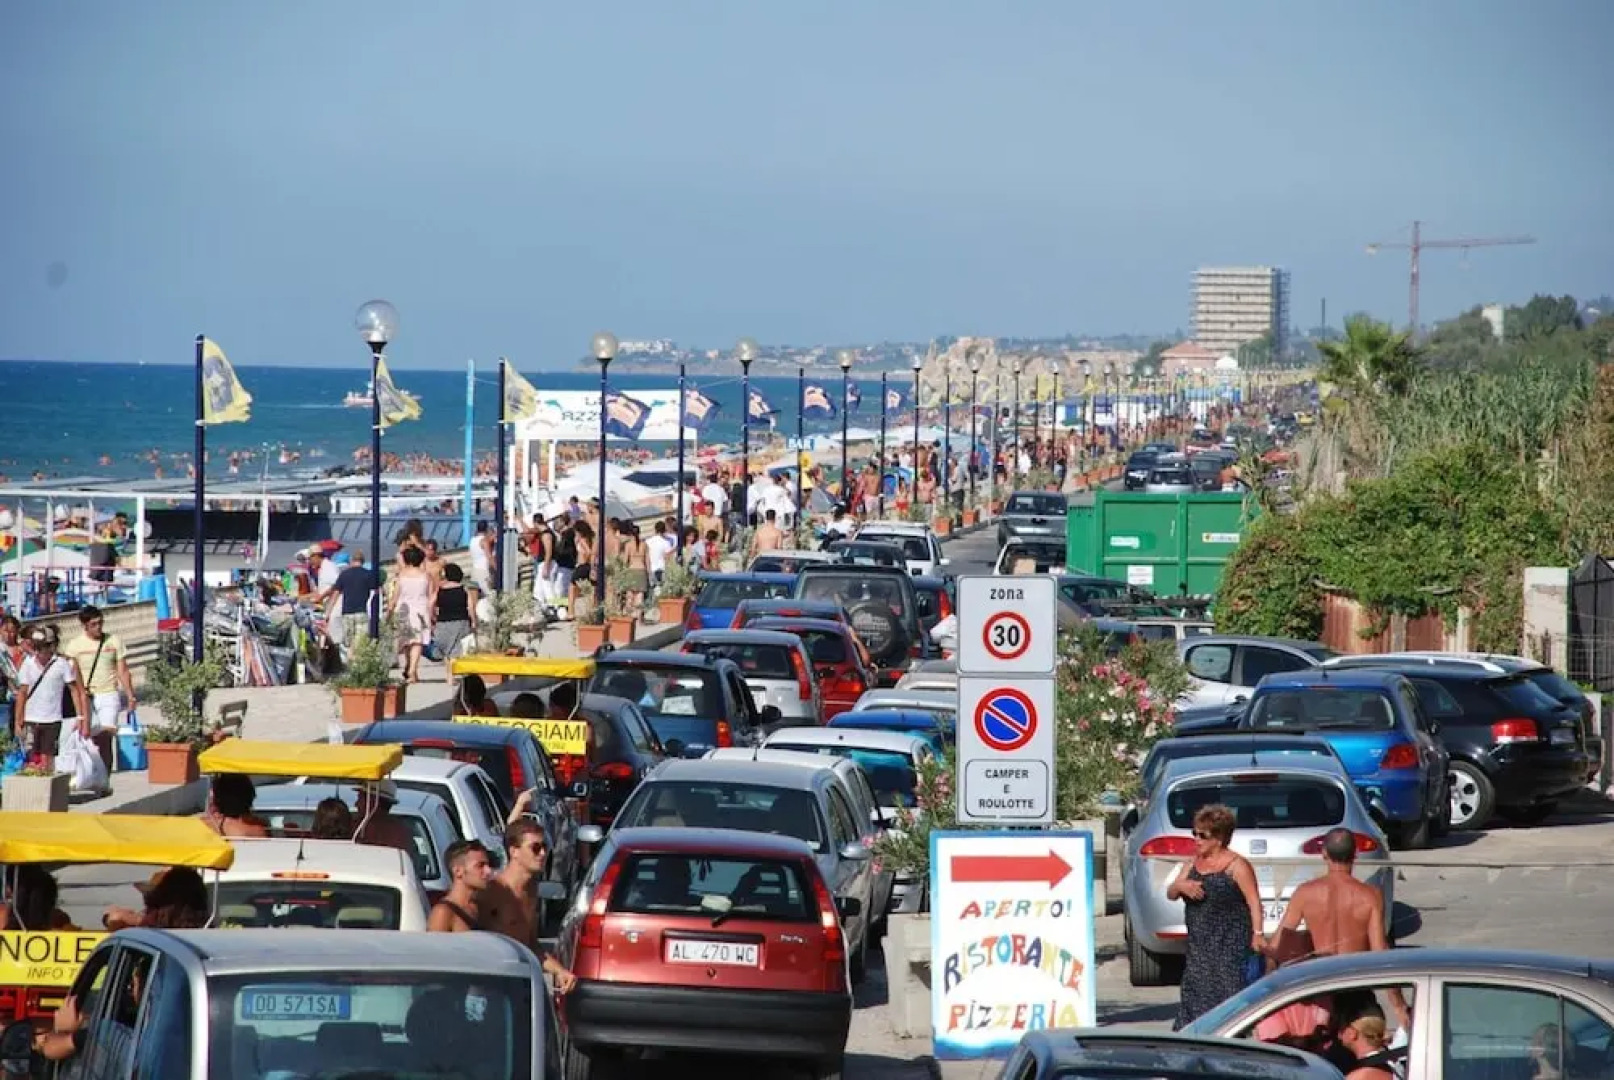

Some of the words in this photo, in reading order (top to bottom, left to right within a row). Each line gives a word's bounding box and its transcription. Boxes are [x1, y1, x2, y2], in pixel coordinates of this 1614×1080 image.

[990, 588, 1024, 600] zona
[993, 625, 1020, 647] 30
[985, 769, 1029, 779] CAMPER
[1003, 784, 1011, 794] E
[978, 798, 1034, 808] ROULOTTE
[959, 899, 1072, 920] APERTO!
[672, 943, 692, 960] AL
[701, 945, 730, 962] 470
[736, 947, 755, 964] WC
[944, 933, 1084, 996] RISTORANTE
[27, 967, 63, 979] INFO
[947, 1000, 1081, 1034] PIZZERIA
